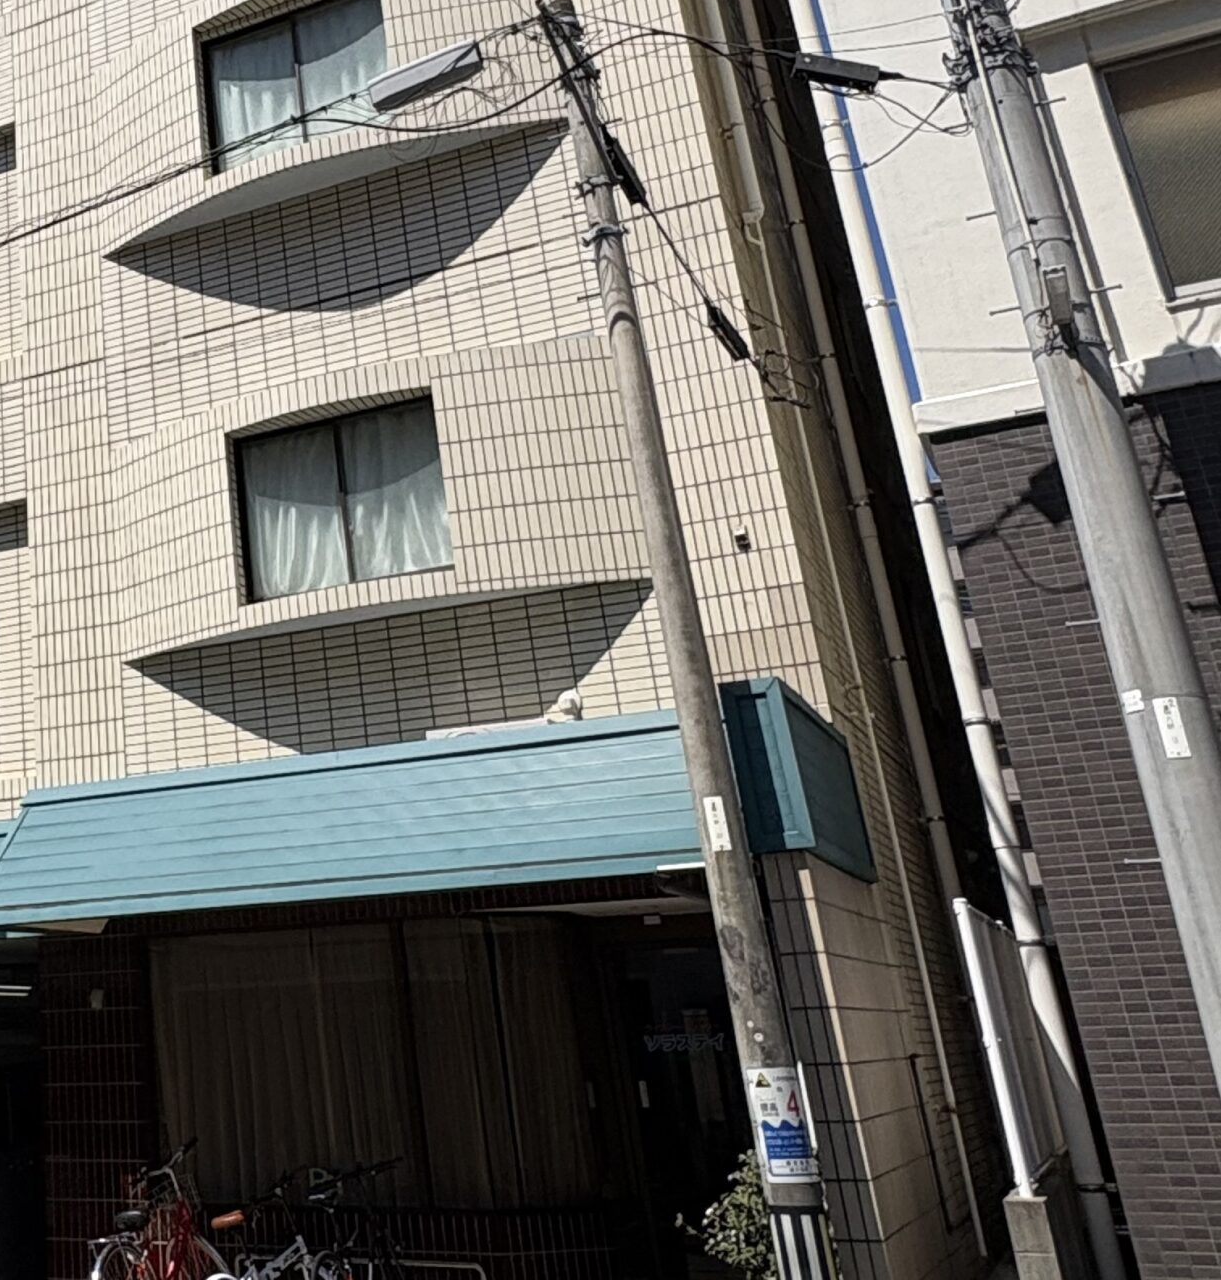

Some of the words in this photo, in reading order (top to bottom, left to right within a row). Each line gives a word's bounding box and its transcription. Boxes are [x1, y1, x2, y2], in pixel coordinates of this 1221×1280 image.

[643, 1032, 725, 1053] ソラステイ
[786, 1090, 800, 1117] 4
